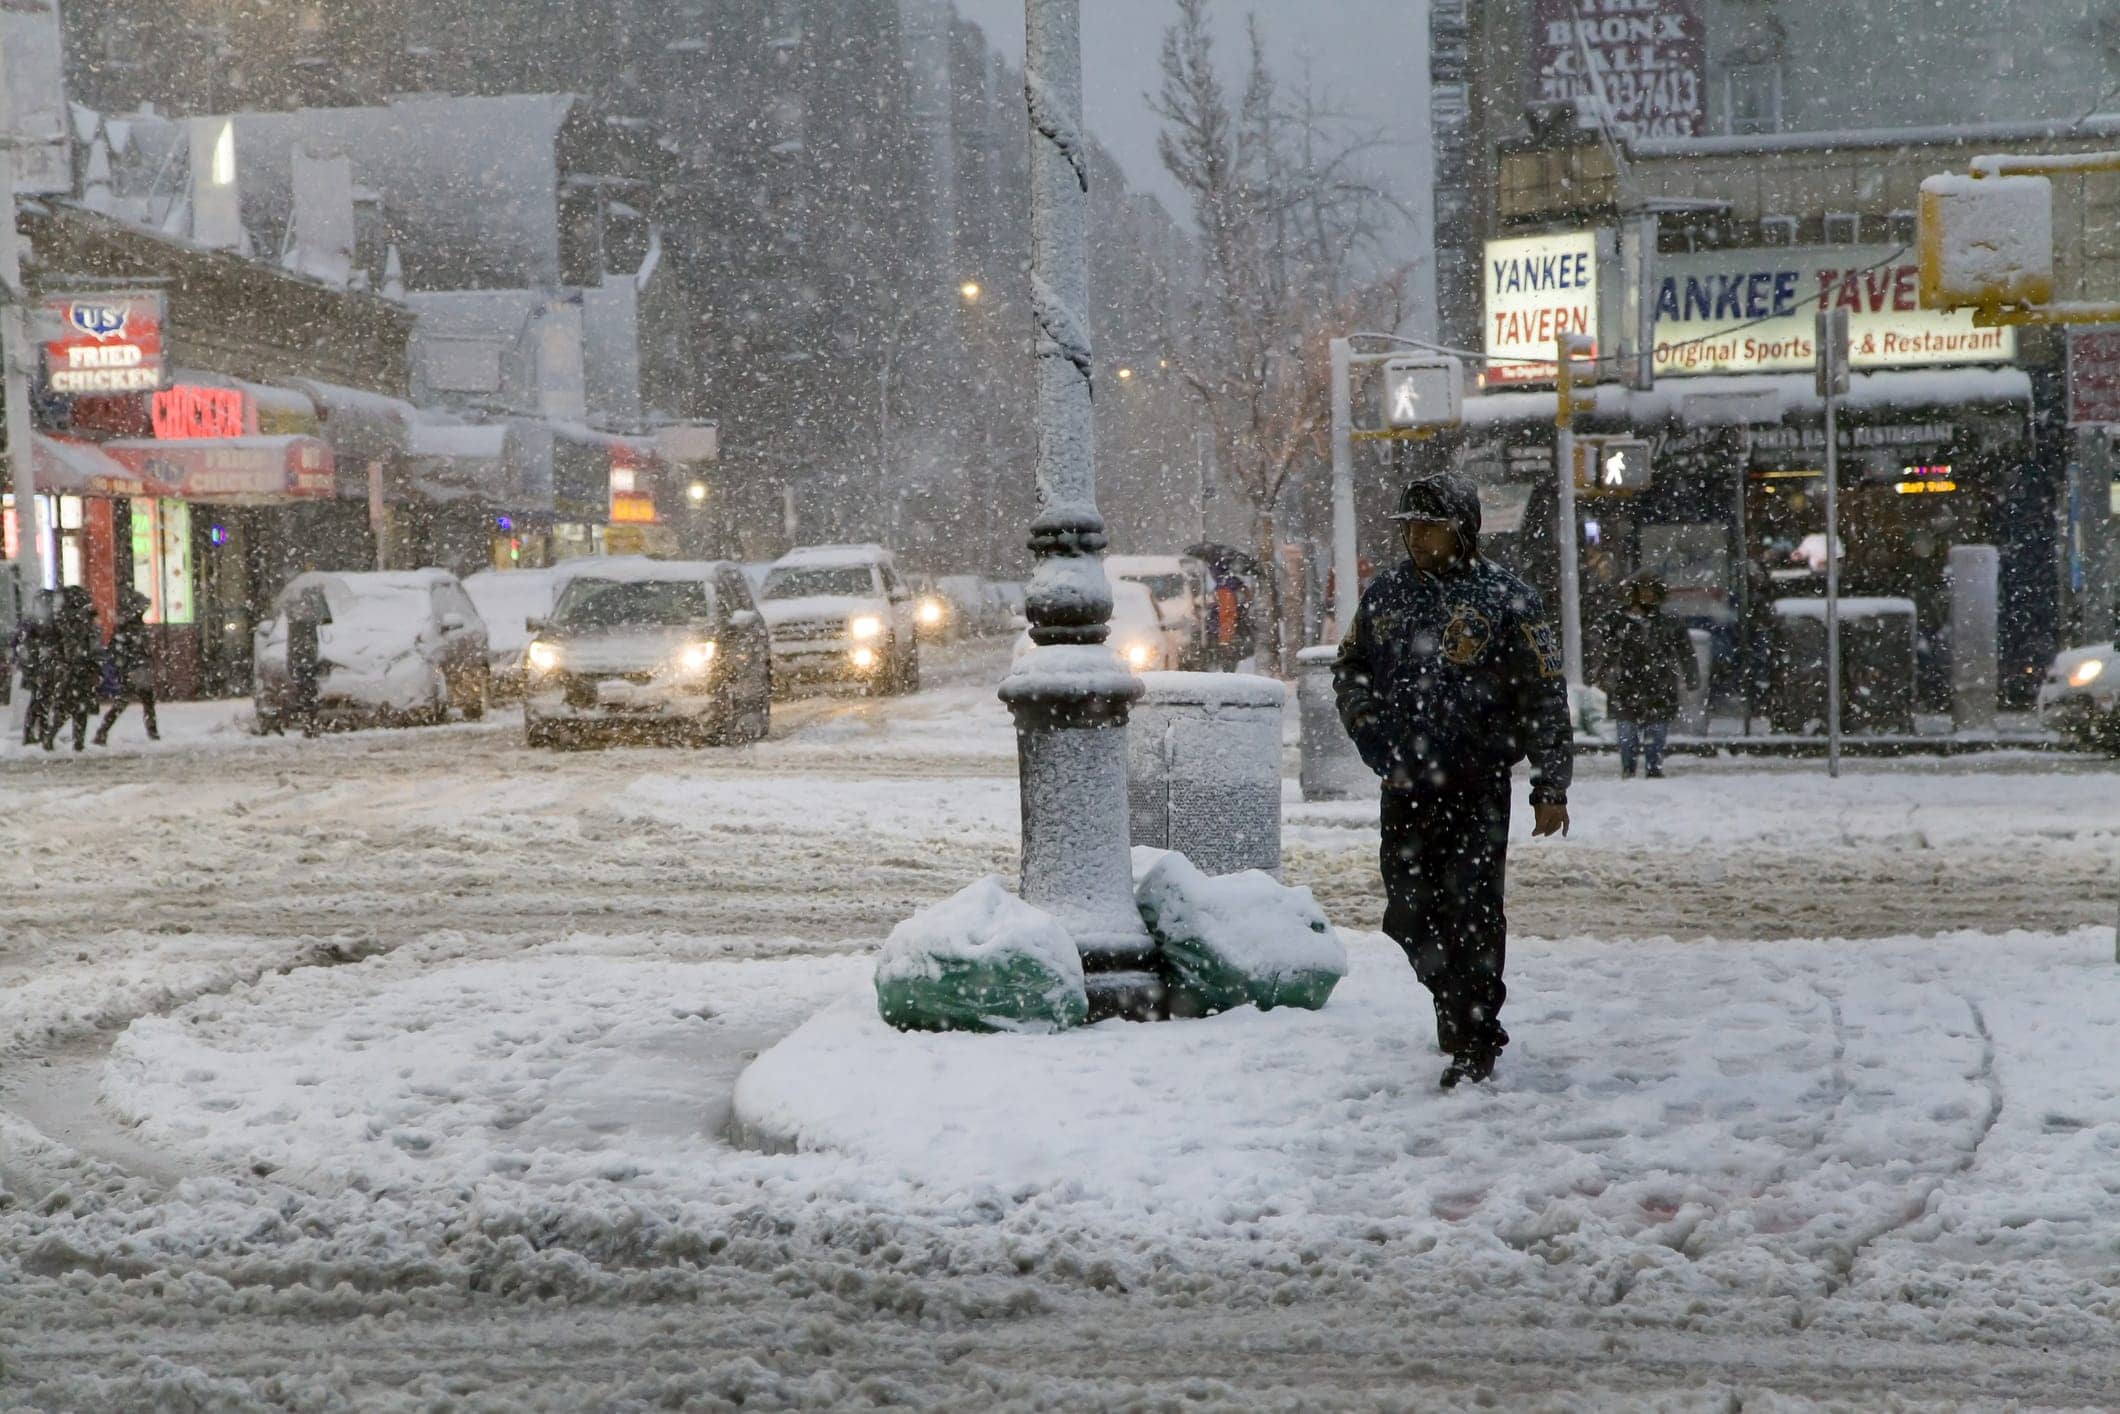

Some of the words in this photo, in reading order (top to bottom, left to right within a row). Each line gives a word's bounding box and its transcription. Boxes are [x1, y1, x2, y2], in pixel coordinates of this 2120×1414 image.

[1546, 14, 1686, 45] BRONX
[1494, 252, 1588, 294] YANKEE
[1656, 271, 1799, 321] ANKEE
[1815, 264, 1919, 313] TAVE
[83, 308, 118, 328] US
[1495, 305, 1588, 345] TAVERN
[68, 344, 142, 369] FRIED
[1655, 340, 1736, 368] Original
[1744, 336, 1812, 363] Sports
[1861, 332, 1876, 354] &
[1883, 328, 2002, 353] Restaurant
[51, 368, 160, 393] CHICKEN
[151, 384, 243, 440] CHICKEN
